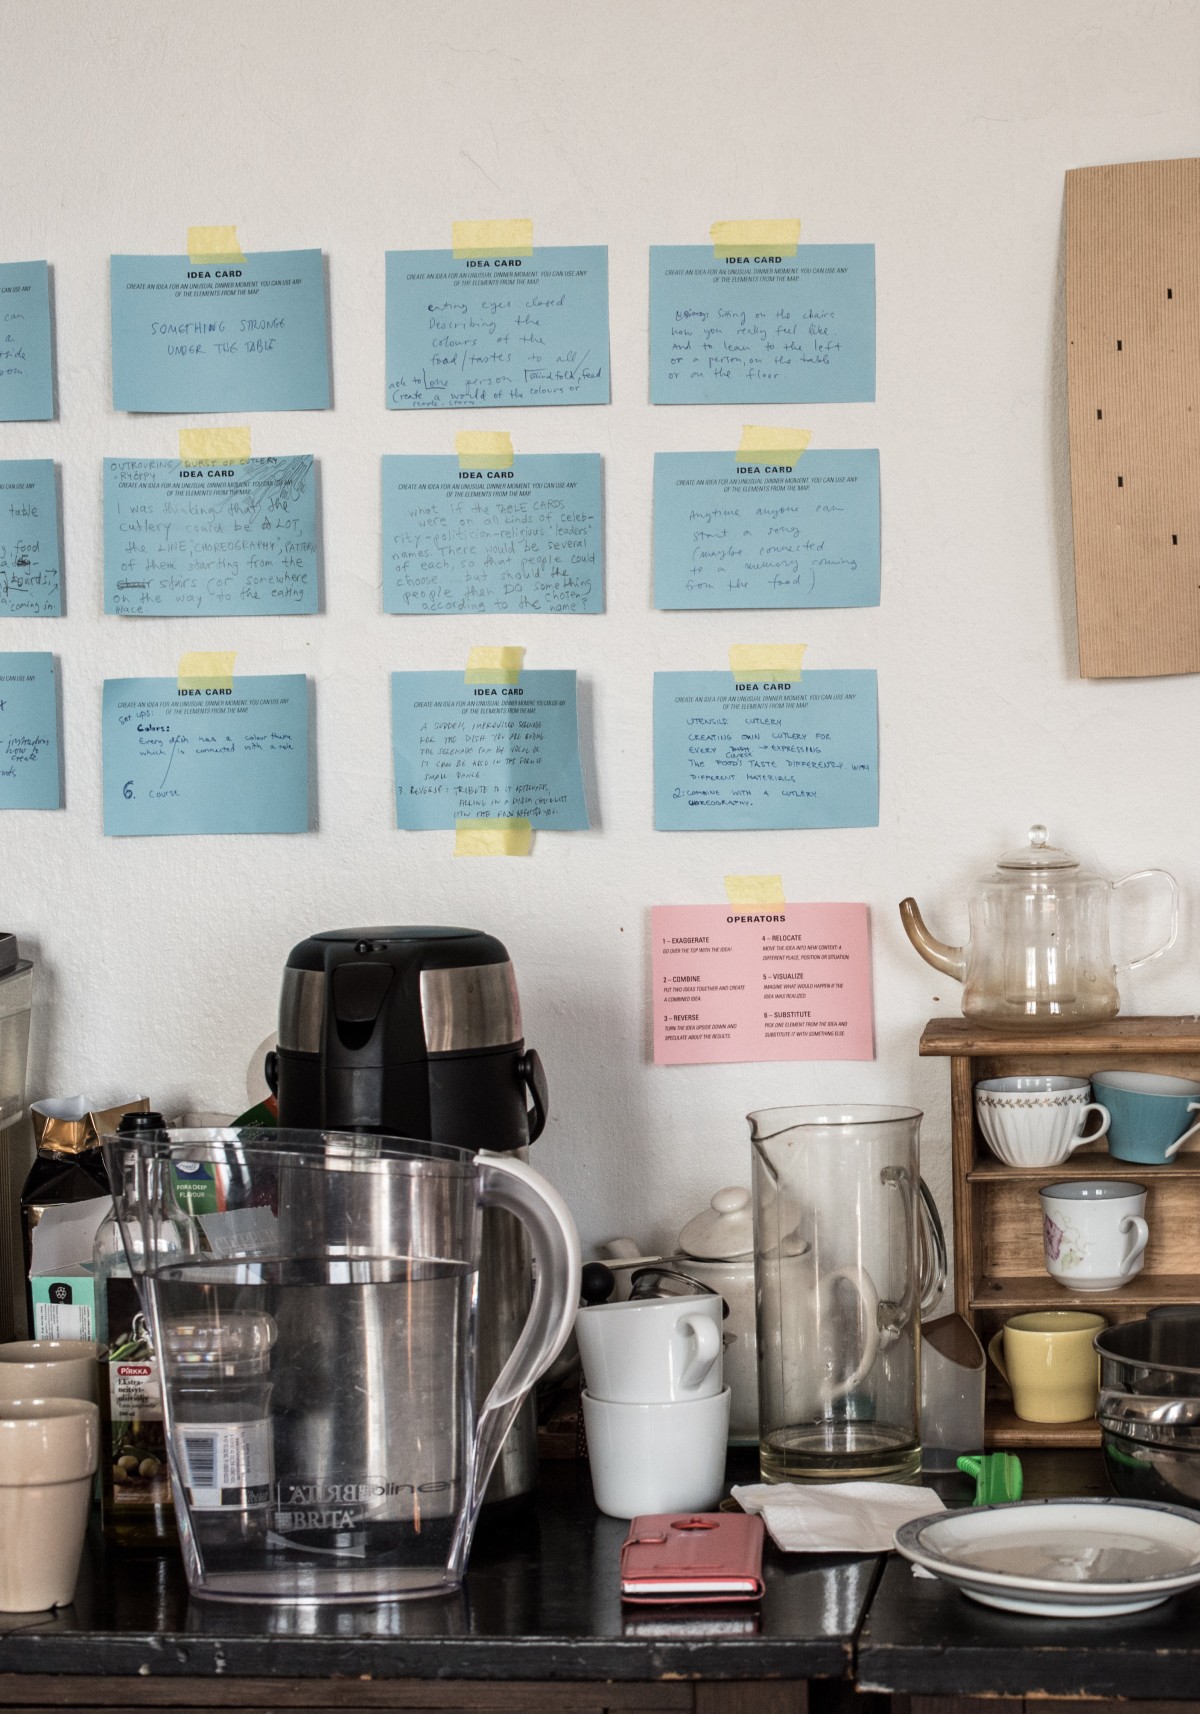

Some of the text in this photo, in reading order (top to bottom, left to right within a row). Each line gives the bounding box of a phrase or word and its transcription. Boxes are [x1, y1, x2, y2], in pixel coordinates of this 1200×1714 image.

[466, 260, 490, 268] IDEA
[725, 256, 782, 264] IDEA CARD
[151, 321, 225, 335] SOMETHING
[168, 344, 207, 356] UNDER
[215, 343, 237, 354] THE
[179, 470, 203, 478] IDEA
[736, 466, 793, 474] IDEA CARD
[763, 683, 791, 691] CARD
[177, 688, 233, 696] IDEA CARD
[474, 688, 524, 696] IDEA CARD
[726, 915, 786, 923] OPERATORS
[294, 1511, 356, 1529] BRITA
